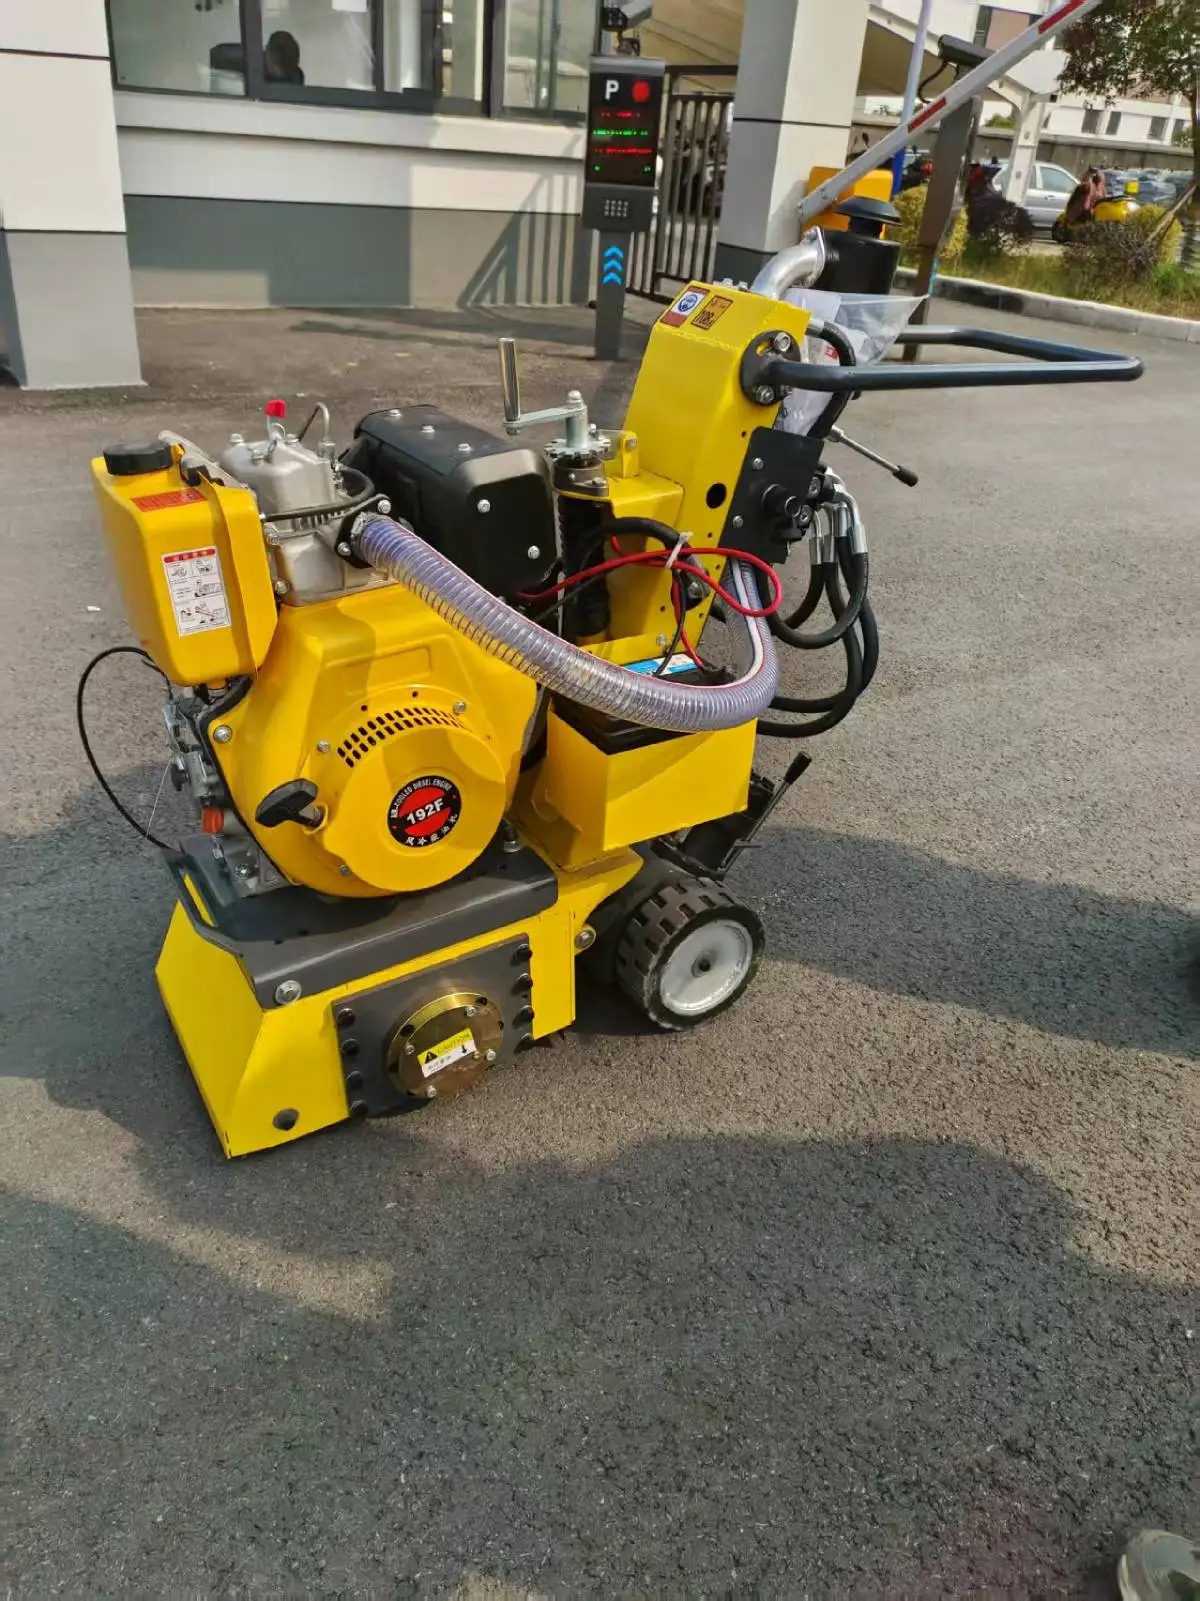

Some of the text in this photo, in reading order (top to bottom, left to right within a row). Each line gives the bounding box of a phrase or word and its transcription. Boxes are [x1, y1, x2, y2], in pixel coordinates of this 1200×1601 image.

[605, 80, 619, 100] P
[413, 778, 431, 790] DIESEL
[432, 778, 453, 791] ENGINE
[406, 798, 444, 825] 192F
